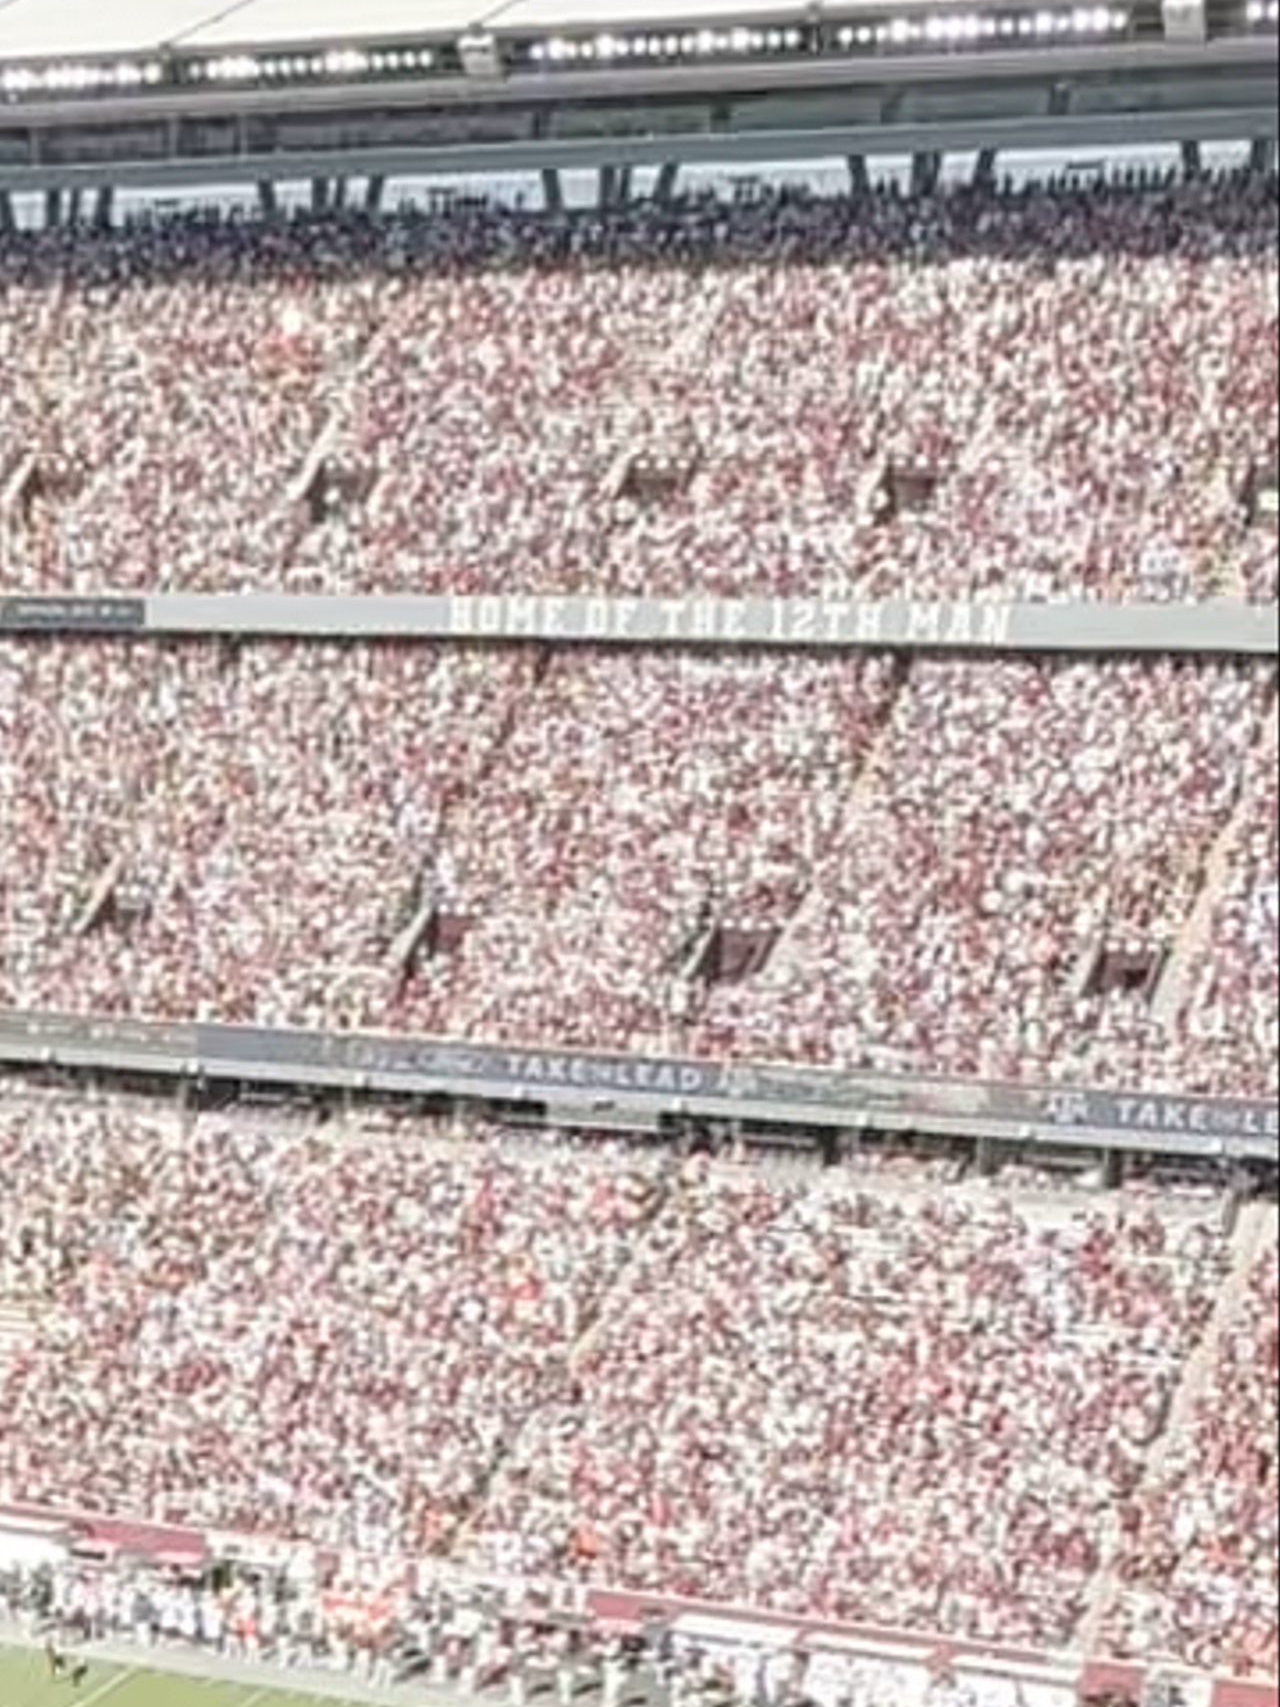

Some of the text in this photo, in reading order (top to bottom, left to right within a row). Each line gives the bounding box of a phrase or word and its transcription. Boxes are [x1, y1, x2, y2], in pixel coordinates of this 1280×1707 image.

[449, 599, 1011, 644] HOME OF THE 12TH MAN
